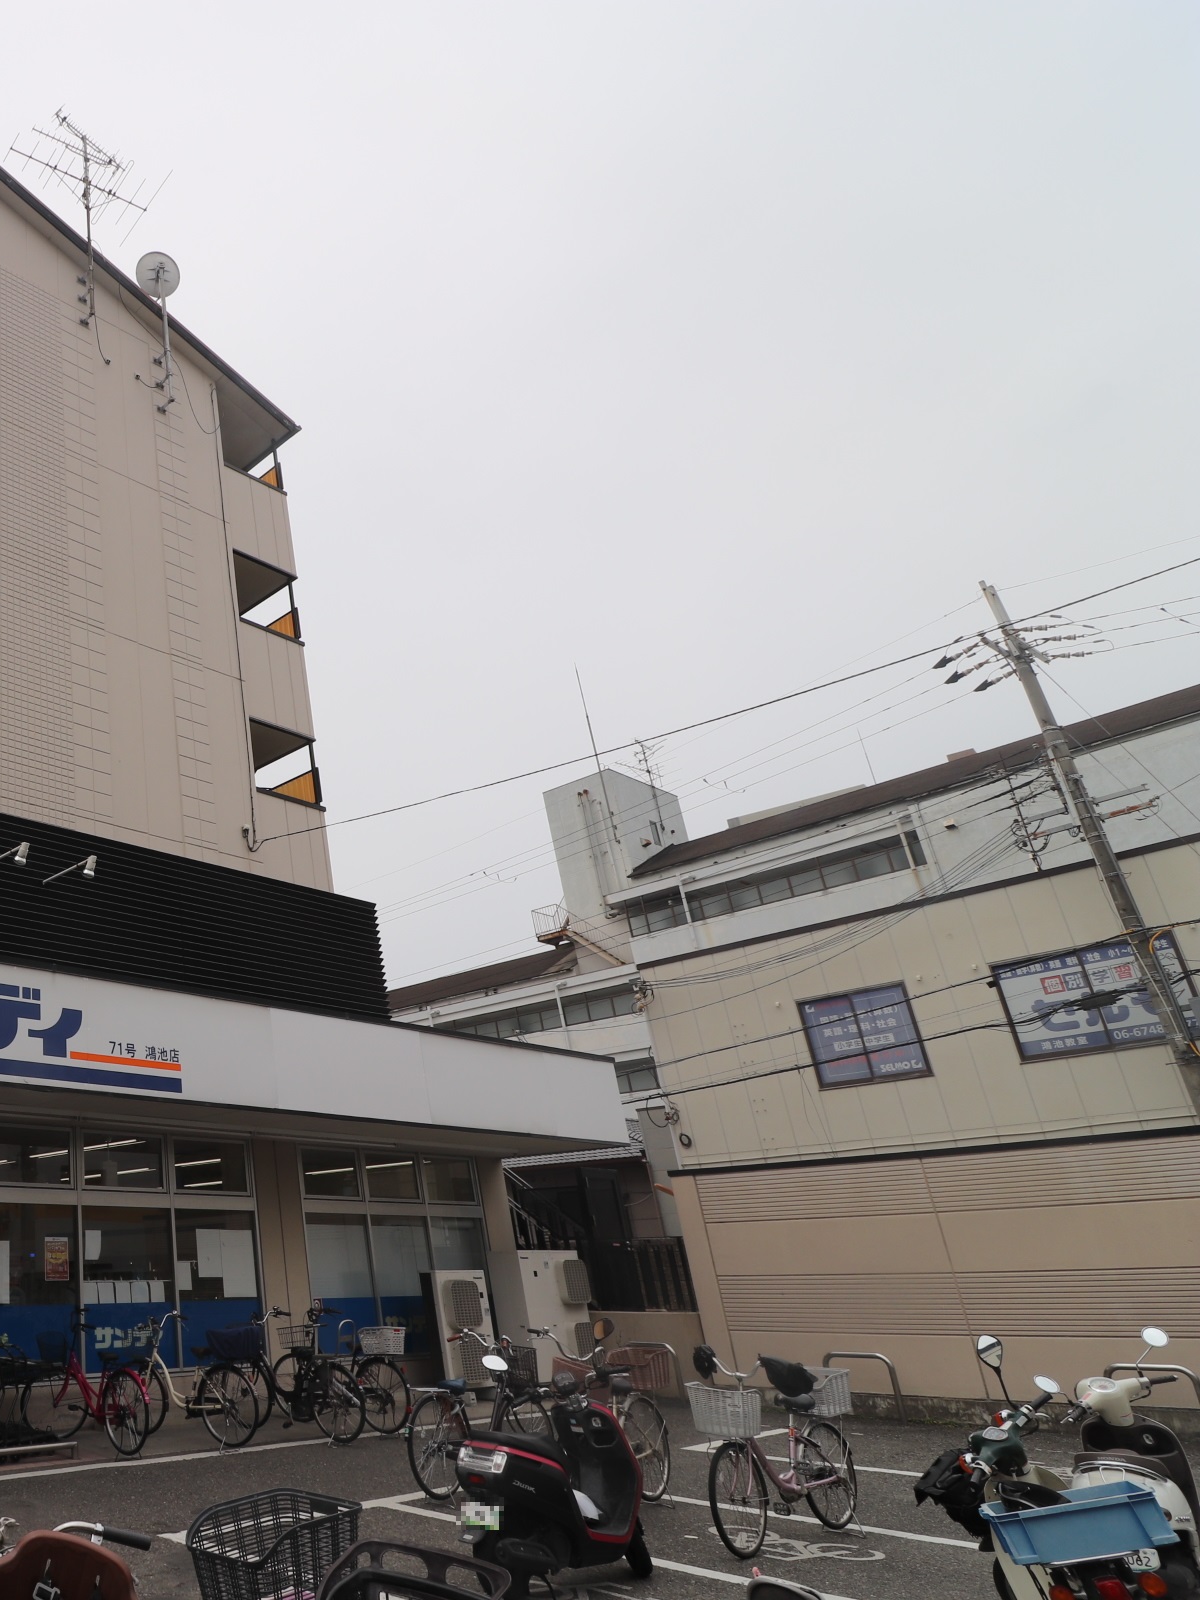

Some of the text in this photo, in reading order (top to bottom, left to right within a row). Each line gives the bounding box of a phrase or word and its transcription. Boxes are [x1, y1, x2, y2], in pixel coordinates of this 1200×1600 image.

[108, 1041, 180, 1063] 71号 鴻池店
[879, 1061, 911, 1073] SELMO
